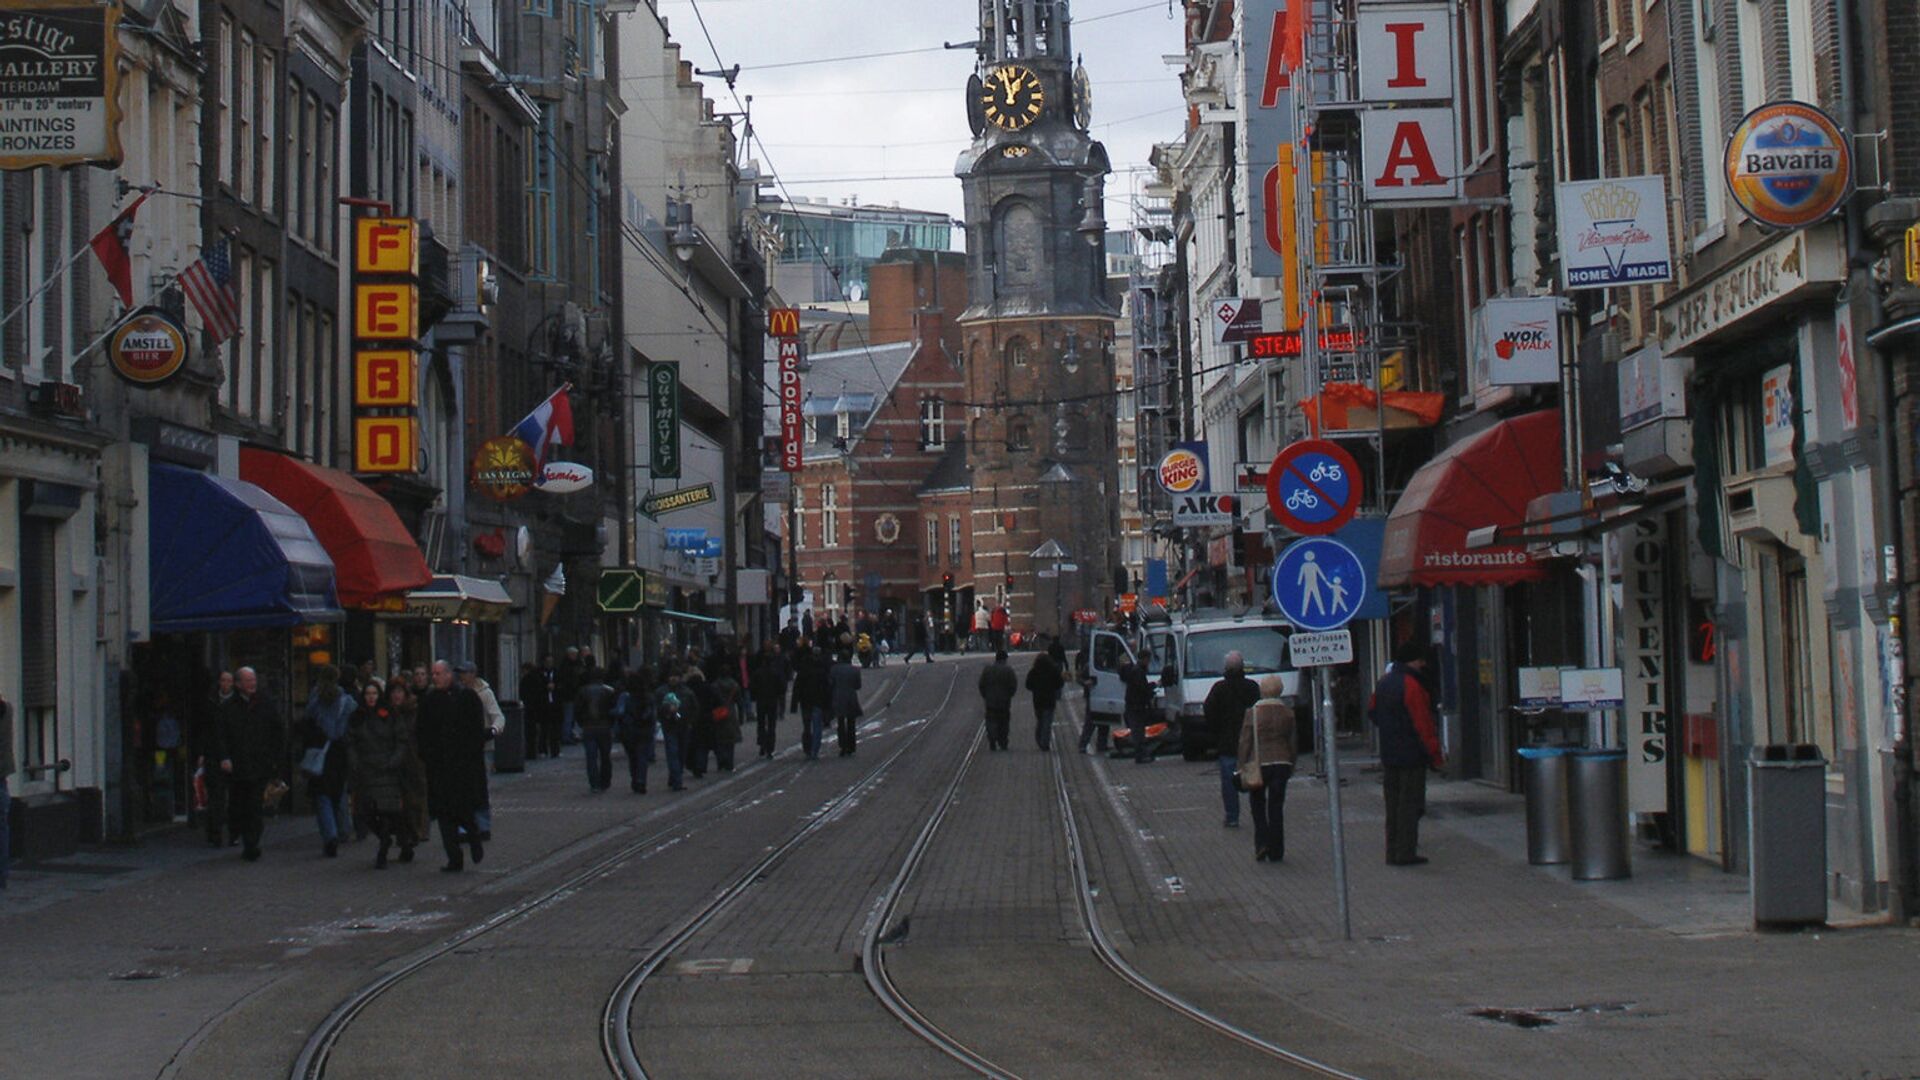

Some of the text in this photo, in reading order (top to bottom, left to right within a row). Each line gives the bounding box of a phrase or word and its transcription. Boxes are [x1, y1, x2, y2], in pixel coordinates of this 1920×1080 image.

[0, 61, 97, 76] ALLERY
[56, 100, 92, 111] century
[0, 136, 75, 149] RONZES
[1747, 150, 1833, 173] Bavaria
[1569, 264, 1667, 282] HOME MADE
[123, 338, 171, 349] AMSTEL
[1503, 330, 1544, 342] WOK
[1514, 340, 1552, 351] WALK
[132, 352, 160, 361] BIER
[781, 343, 799, 468] McDonalds
[477, 470, 533, 479] LAS VEGAS
[1161, 458, 1197, 475] BURGER
[1163, 466, 1198, 486] KING
[645, 487, 710, 513] CROISSANTERIE
[1423, 550, 1527, 567] ristorante
[1635, 518, 1666, 764] SOUVENIRS
